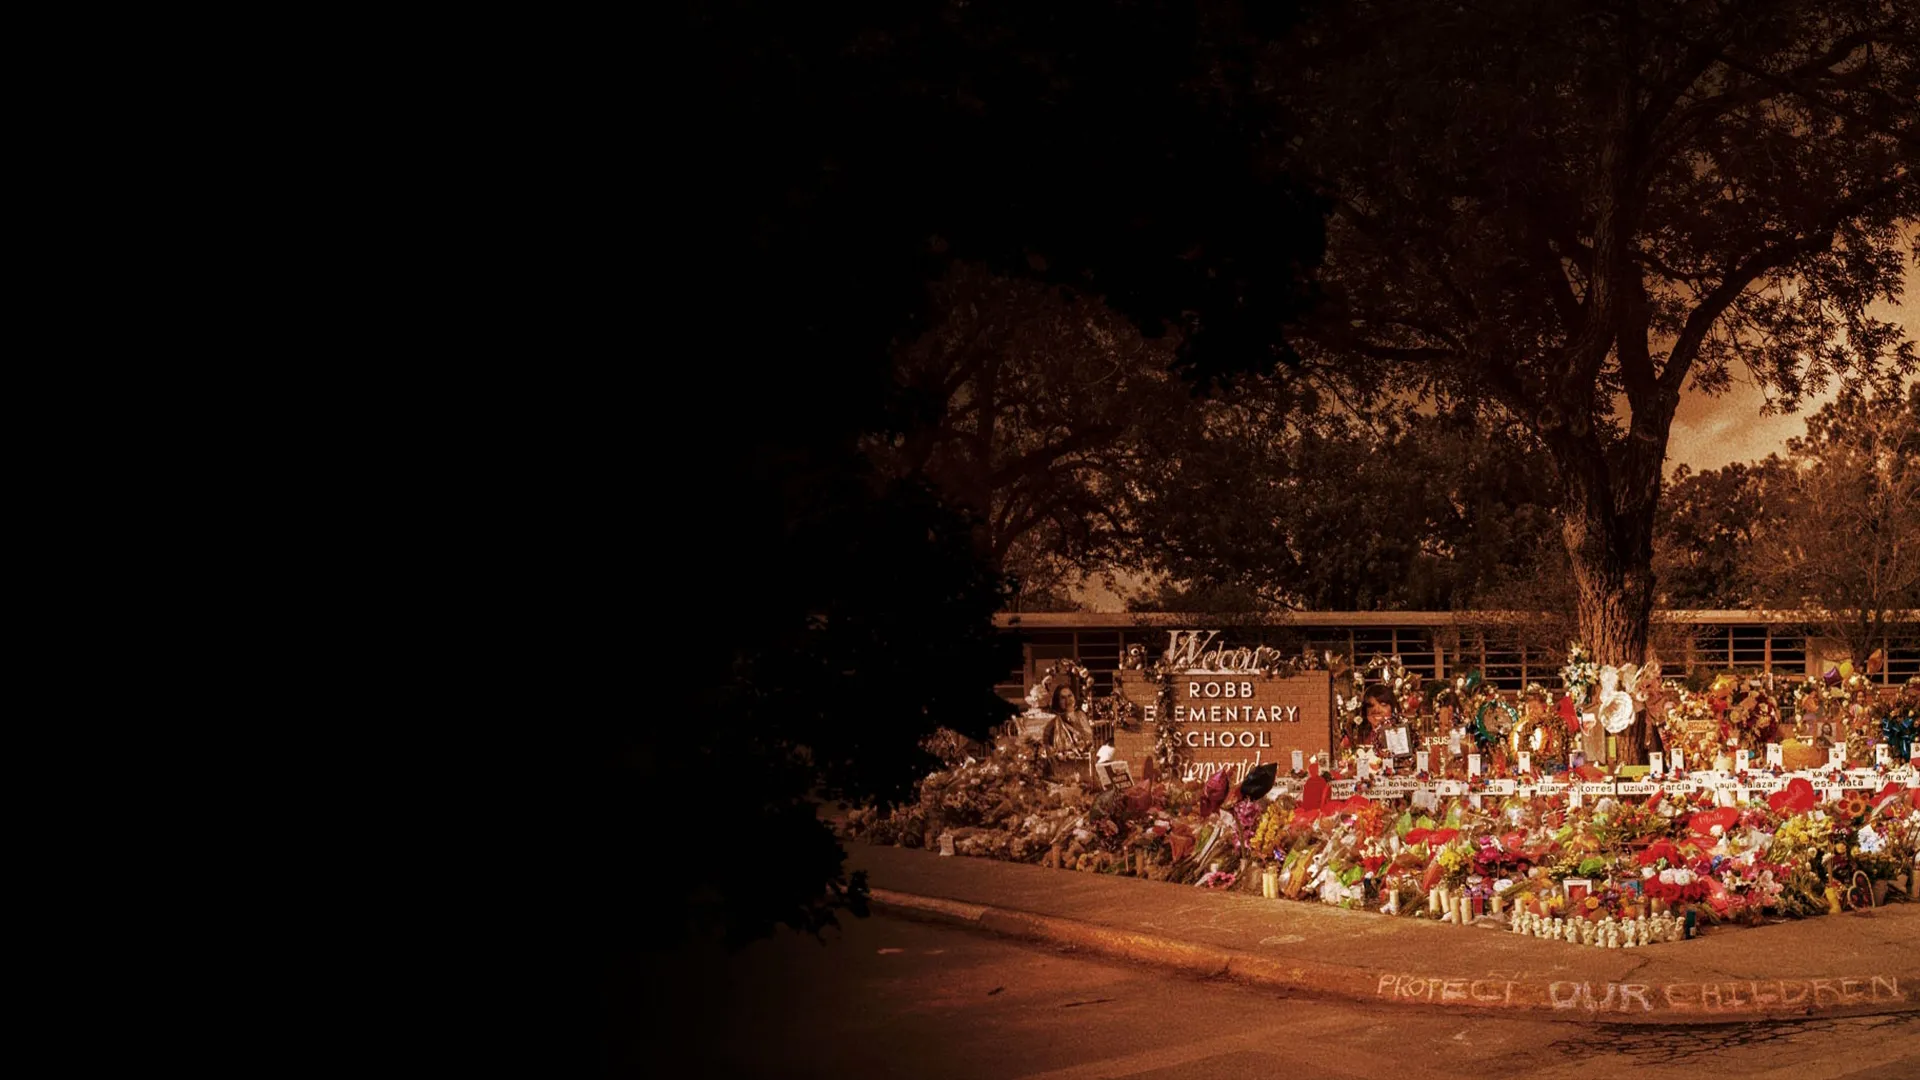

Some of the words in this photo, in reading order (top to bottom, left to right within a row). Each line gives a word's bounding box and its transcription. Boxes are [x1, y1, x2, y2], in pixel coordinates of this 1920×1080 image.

[1189, 682, 1253, 698] ROBB
[1144, 706, 1298, 722] EEMENTARY
[1173, 731, 1270, 747] SCHOOL
[1623, 785, 1655, 793] Uziyah
[1659, 783, 1691, 791] Garcia
[1377, 974, 1520, 1004] PROTECT
[1549, 979, 1653, 1011] OUR
[1665, 975, 1900, 1012] CHILDREN
